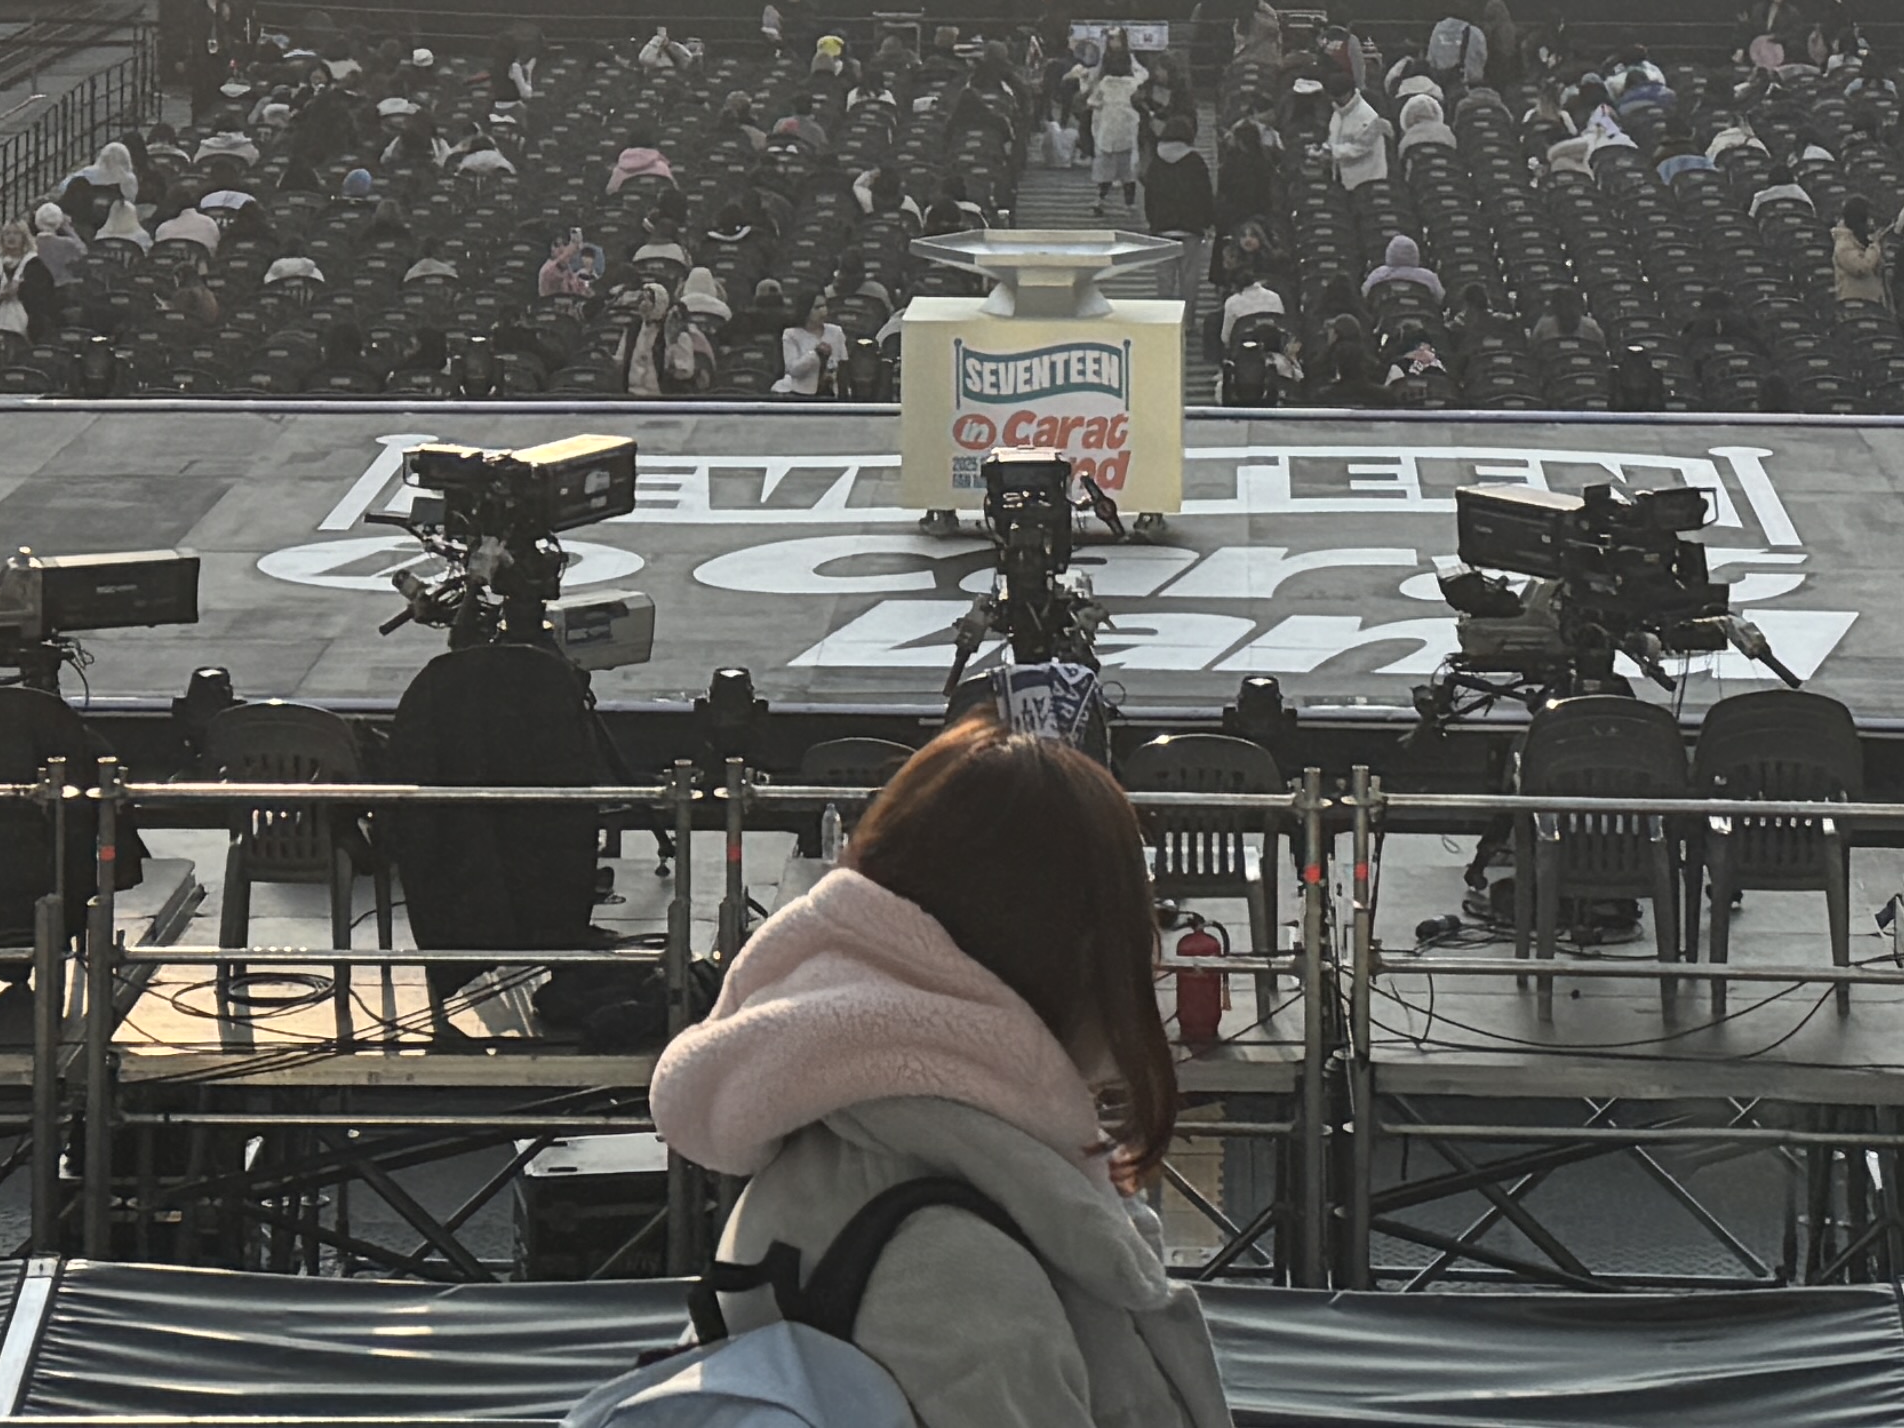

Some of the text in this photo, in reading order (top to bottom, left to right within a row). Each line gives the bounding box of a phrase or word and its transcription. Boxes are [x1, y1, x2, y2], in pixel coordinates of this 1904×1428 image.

[964, 350, 1120, 396] SEVENTEEN
[960, 409, 1129, 450] in Carat
